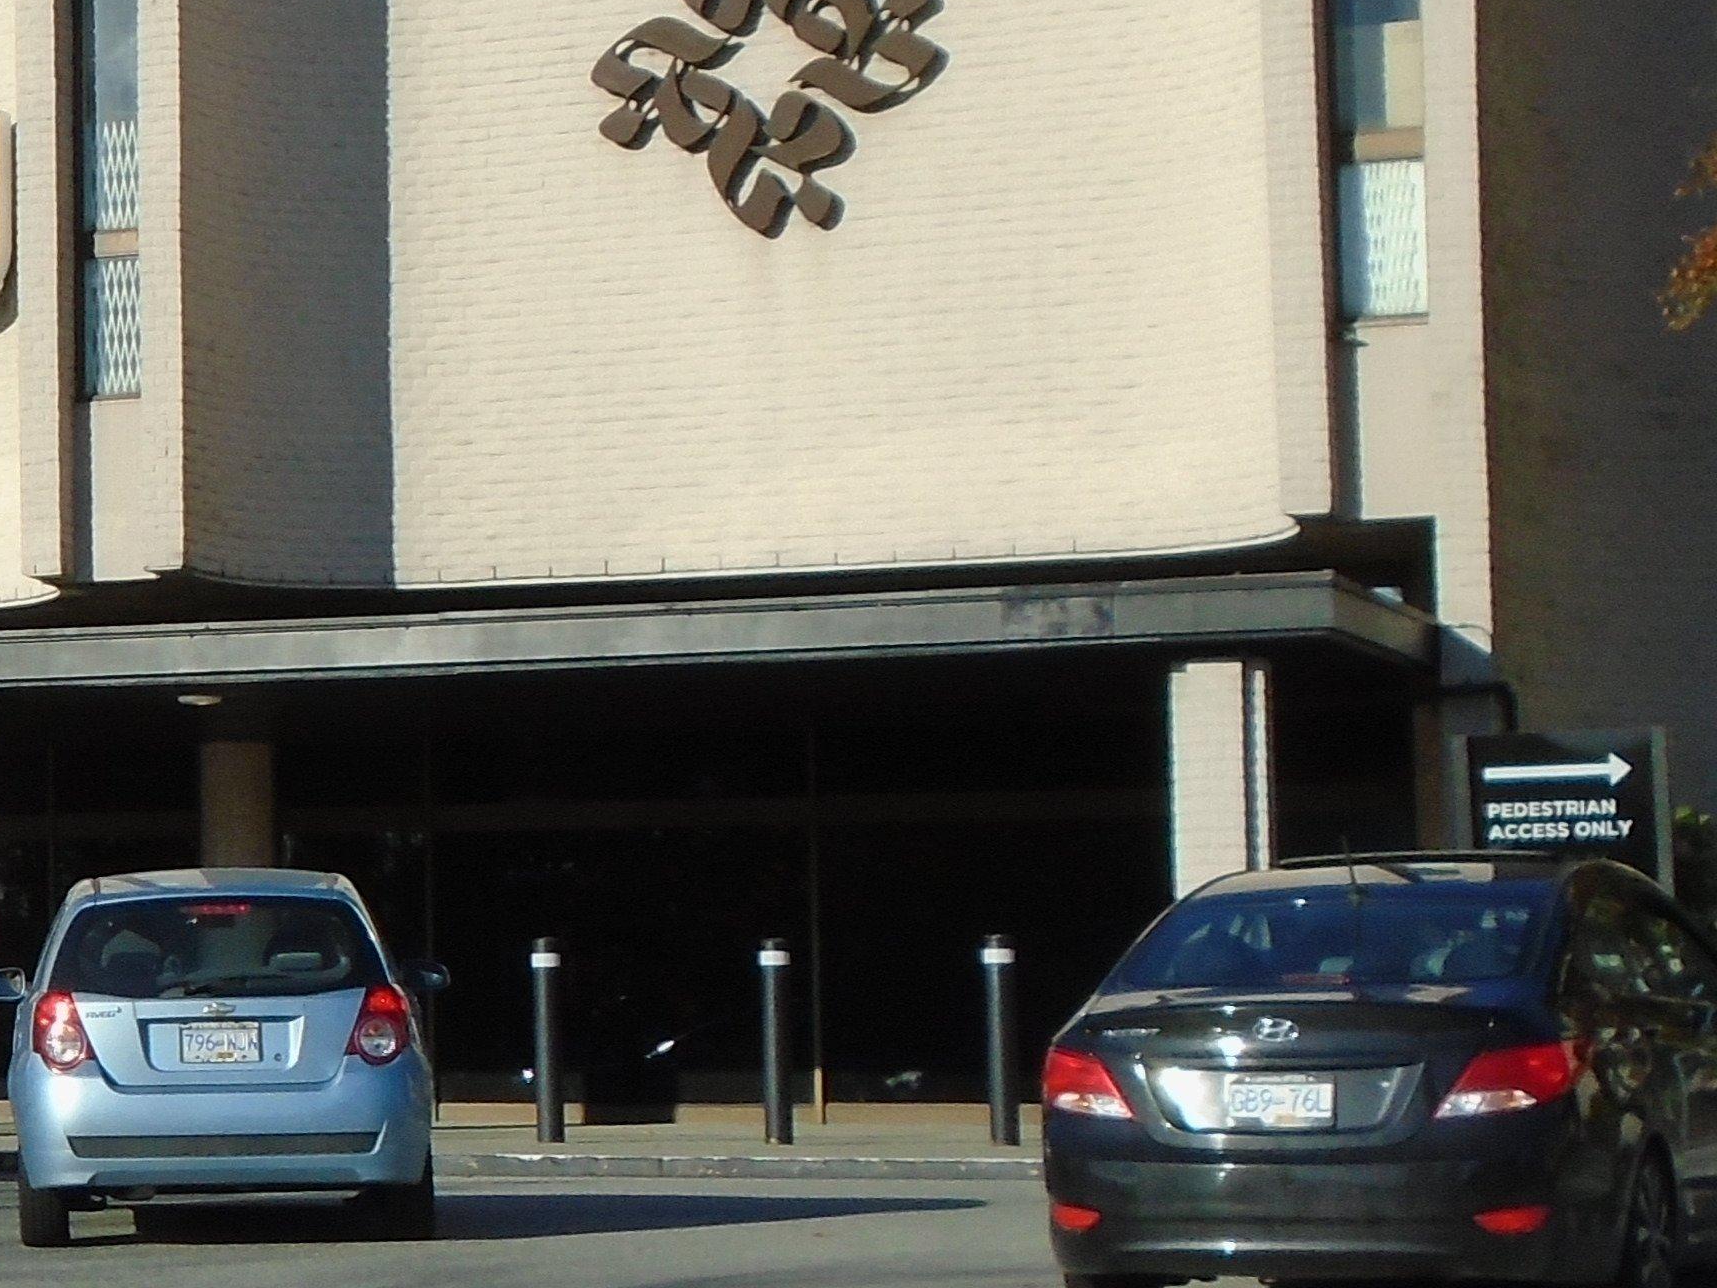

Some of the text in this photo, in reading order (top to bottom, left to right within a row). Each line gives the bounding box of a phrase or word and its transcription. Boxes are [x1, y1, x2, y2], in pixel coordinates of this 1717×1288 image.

[1486, 798, 1618, 819] PEDESTRIAN
[1488, 819, 1634, 841] ACCESS ONLY
